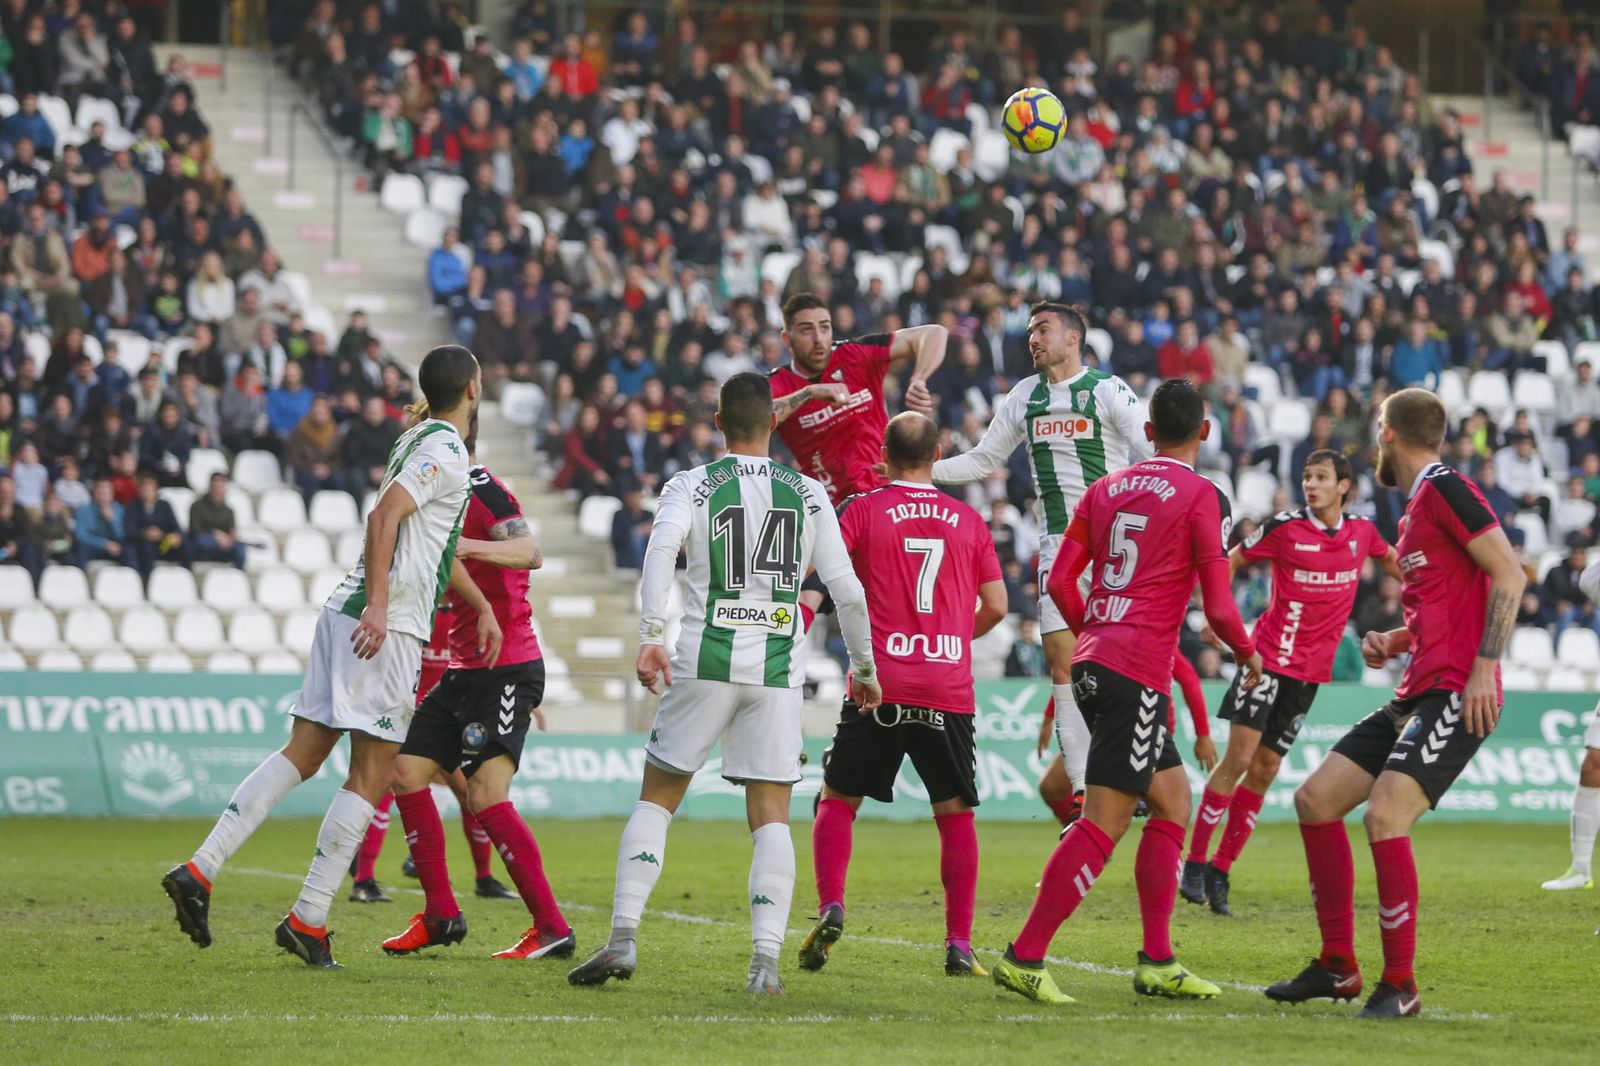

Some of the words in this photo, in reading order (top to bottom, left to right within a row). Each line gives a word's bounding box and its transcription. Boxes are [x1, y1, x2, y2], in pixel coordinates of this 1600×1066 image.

[798, 388, 873, 429] SOLSS
[1036, 419, 1088, 438] tango
[693, 467, 731, 507] SERGI
[733, 464, 822, 516] GUARDIOLA
[1108, 475, 1176, 502] GAFFOOR
[886, 502, 960, 528] ZOZULIA
[712, 505, 800, 592] 14
[1101, 511, 1149, 592] 5
[904, 537, 945, 614] 7
[717, 607, 768, 622] PiEDRA
[1251, 673, 1279, 706] 23
